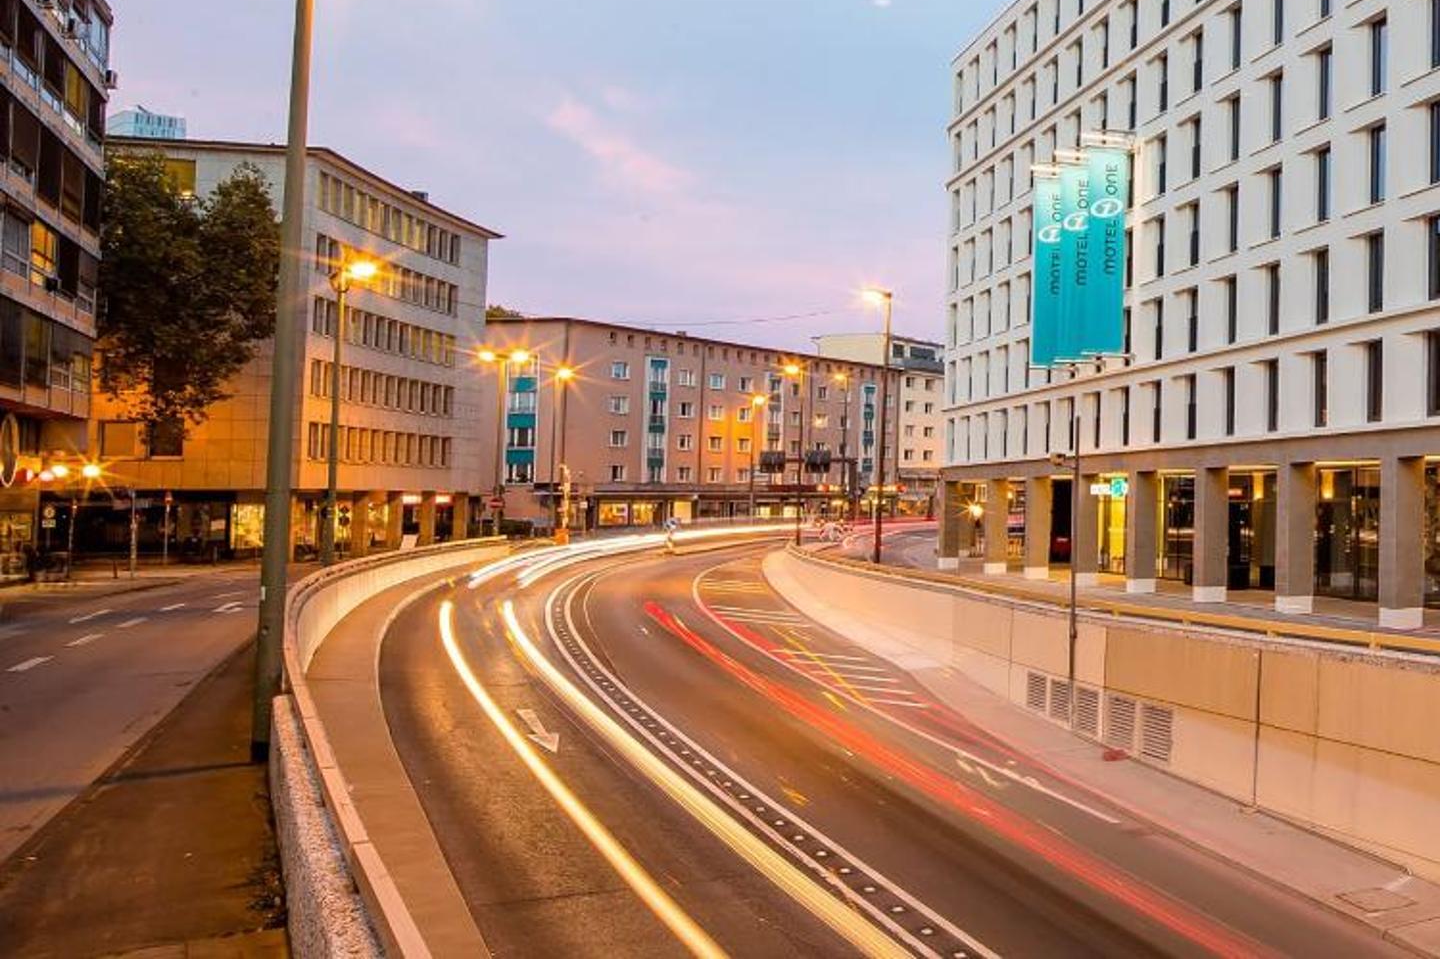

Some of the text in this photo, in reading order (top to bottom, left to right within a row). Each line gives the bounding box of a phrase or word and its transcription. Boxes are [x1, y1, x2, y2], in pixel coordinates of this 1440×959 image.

[1076, 179, 1089, 286] MOTEL ONE
[1104, 164, 1119, 274] MOTEL ONE
